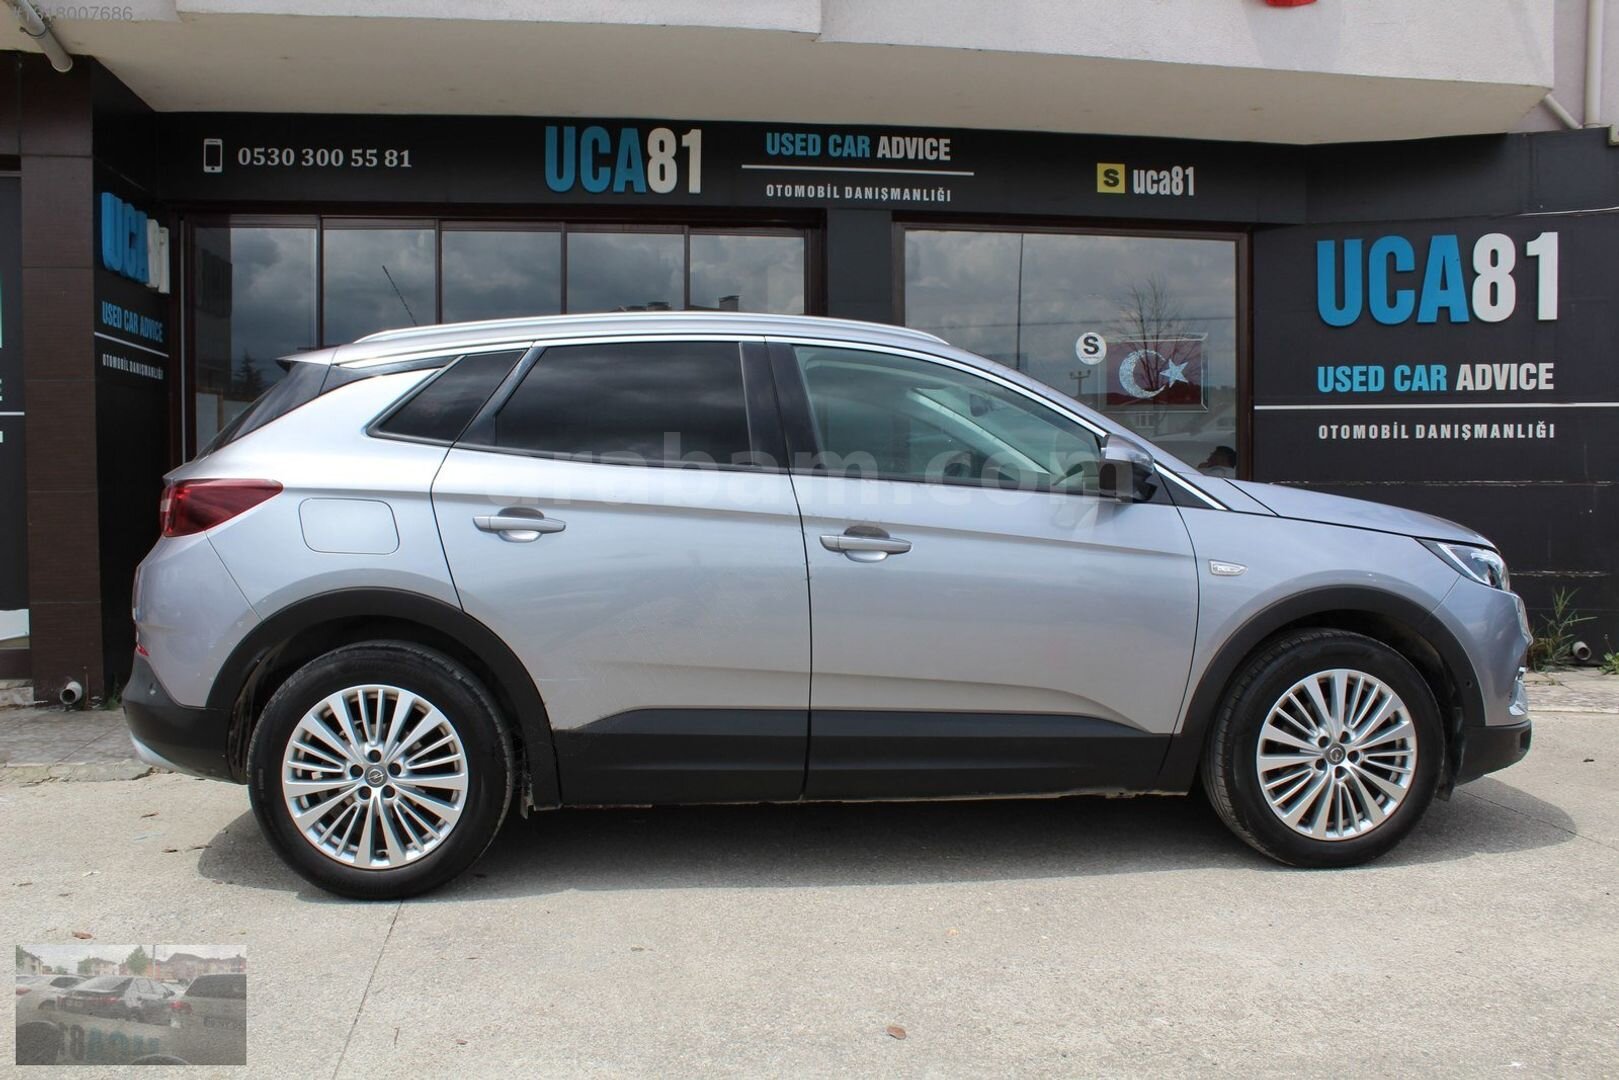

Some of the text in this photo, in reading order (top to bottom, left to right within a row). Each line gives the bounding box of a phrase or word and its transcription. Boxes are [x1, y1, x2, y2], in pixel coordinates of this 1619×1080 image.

[237, 147, 413, 168] 0530 300 55 81
[544, 125, 702, 194] UCA81
[766, 132, 951, 161] USED CAR ADVICE
[766, 183, 951, 203] OTOMOBİL DANIŞMANLIĞI
[1132, 166, 1195, 196] uca81
[1316, 231, 1558, 326] UCA81
[102, 301, 122, 329] USED
[123, 310, 139, 335] CAR
[1317, 363, 1555, 393] USED CAR ADVICE
[1318, 420, 1555, 441] OTOMOBİL DANIŞMANLIĞI
